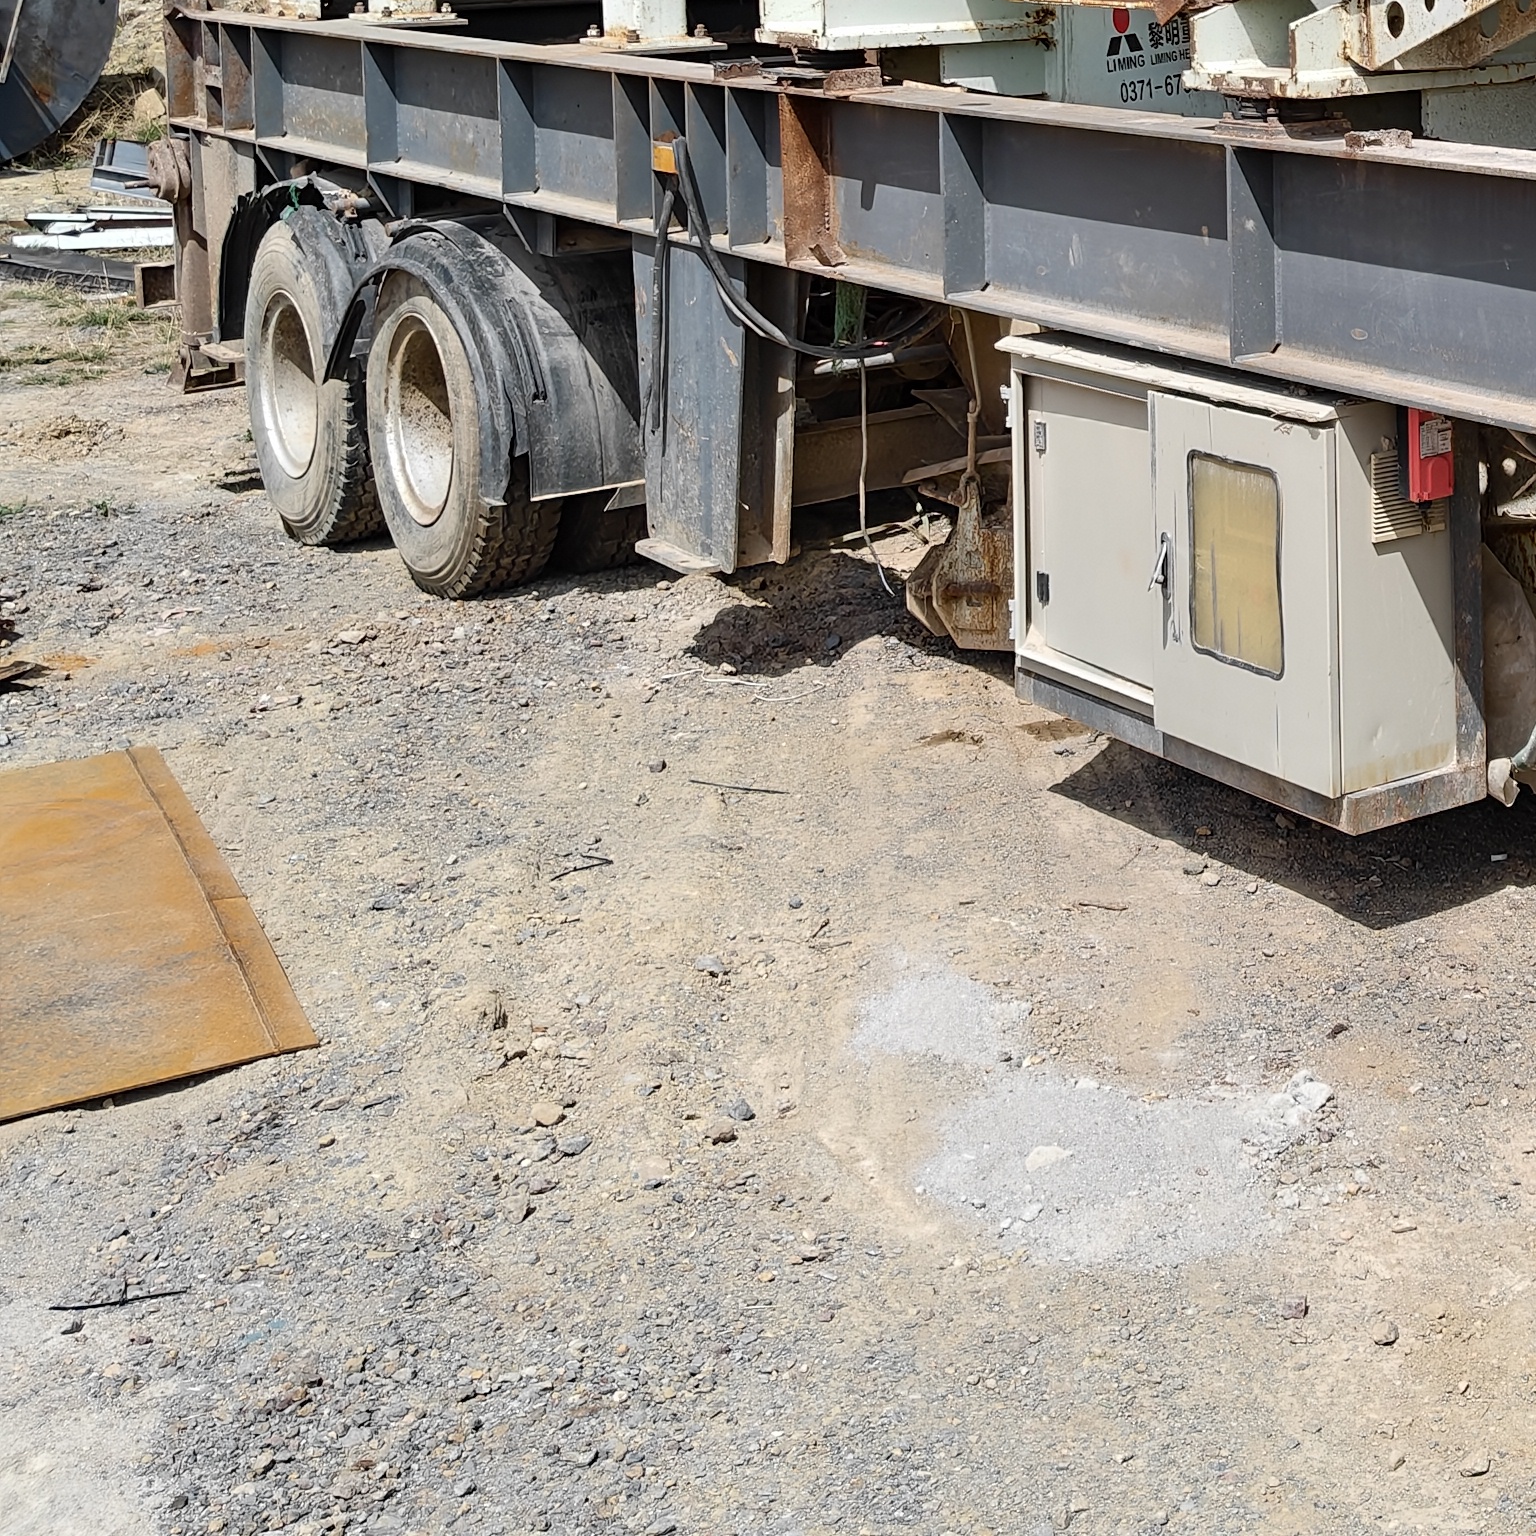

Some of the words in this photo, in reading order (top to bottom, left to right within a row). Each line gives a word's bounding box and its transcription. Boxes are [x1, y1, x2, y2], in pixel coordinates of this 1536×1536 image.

[1106, 54, 1146, 73] LIMING
[1150, 51, 1178, 65] LIMING
[1120, 73, 1200, 103] 0371-67
